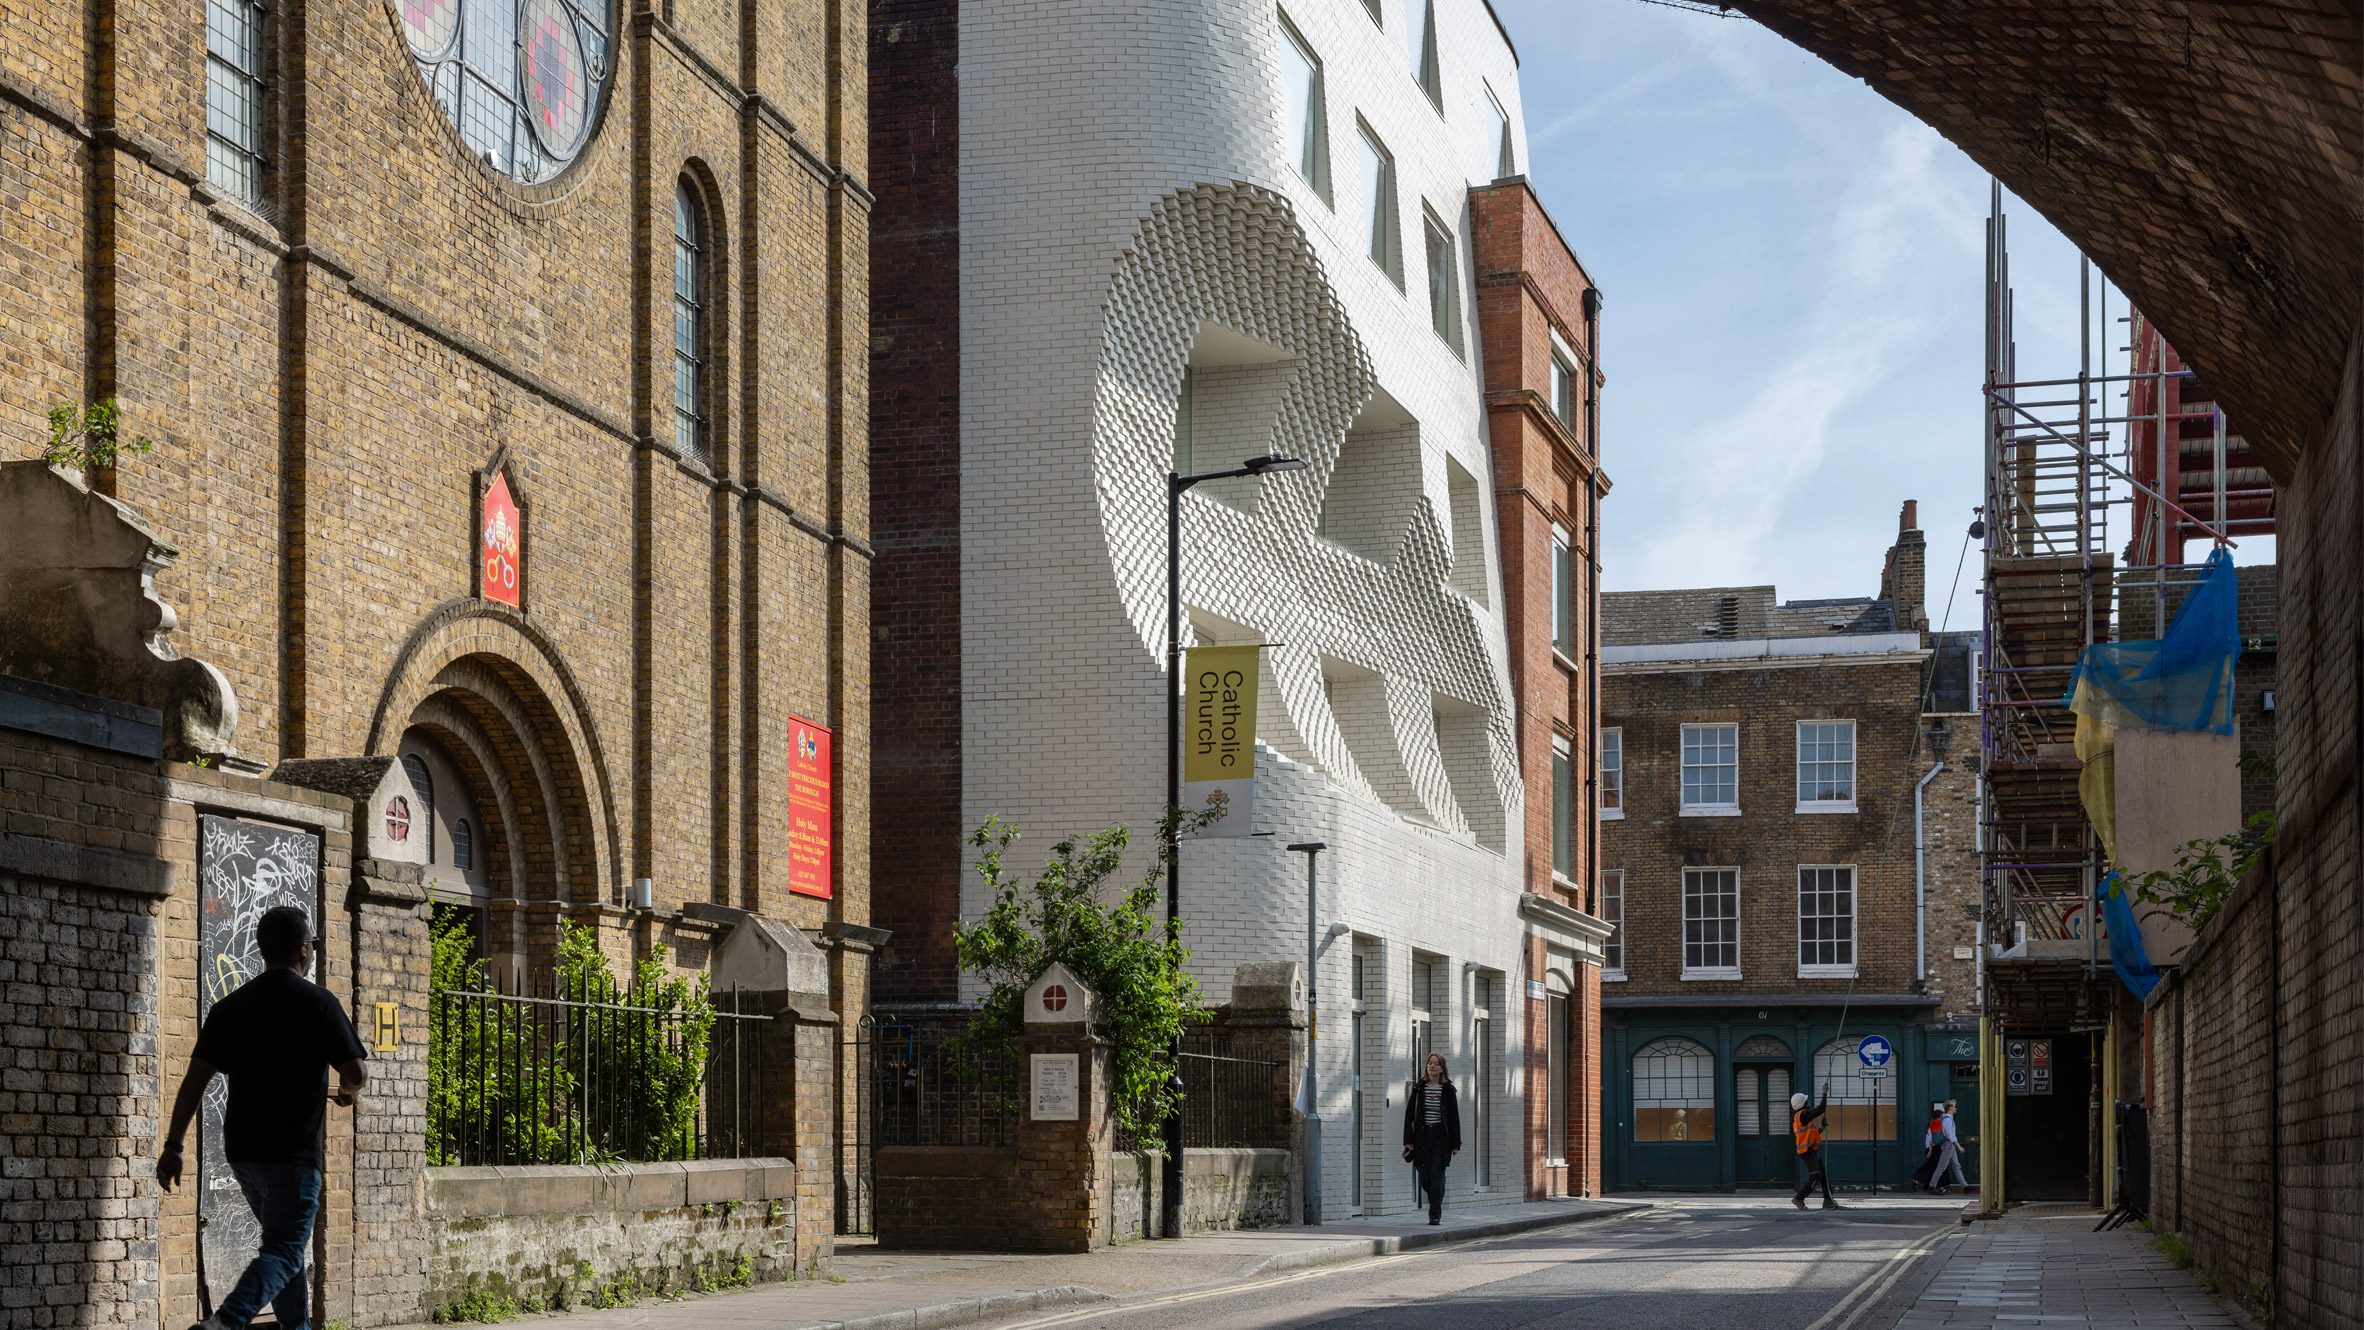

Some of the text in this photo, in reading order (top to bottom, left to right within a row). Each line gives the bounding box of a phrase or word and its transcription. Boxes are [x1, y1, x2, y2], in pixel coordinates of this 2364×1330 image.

[1198, 671, 1219, 755] Church
[1220, 670, 1243, 767] Catholic
[379, 1007, 395, 1046] H
[1950, 1036, 1974, 1057] The
